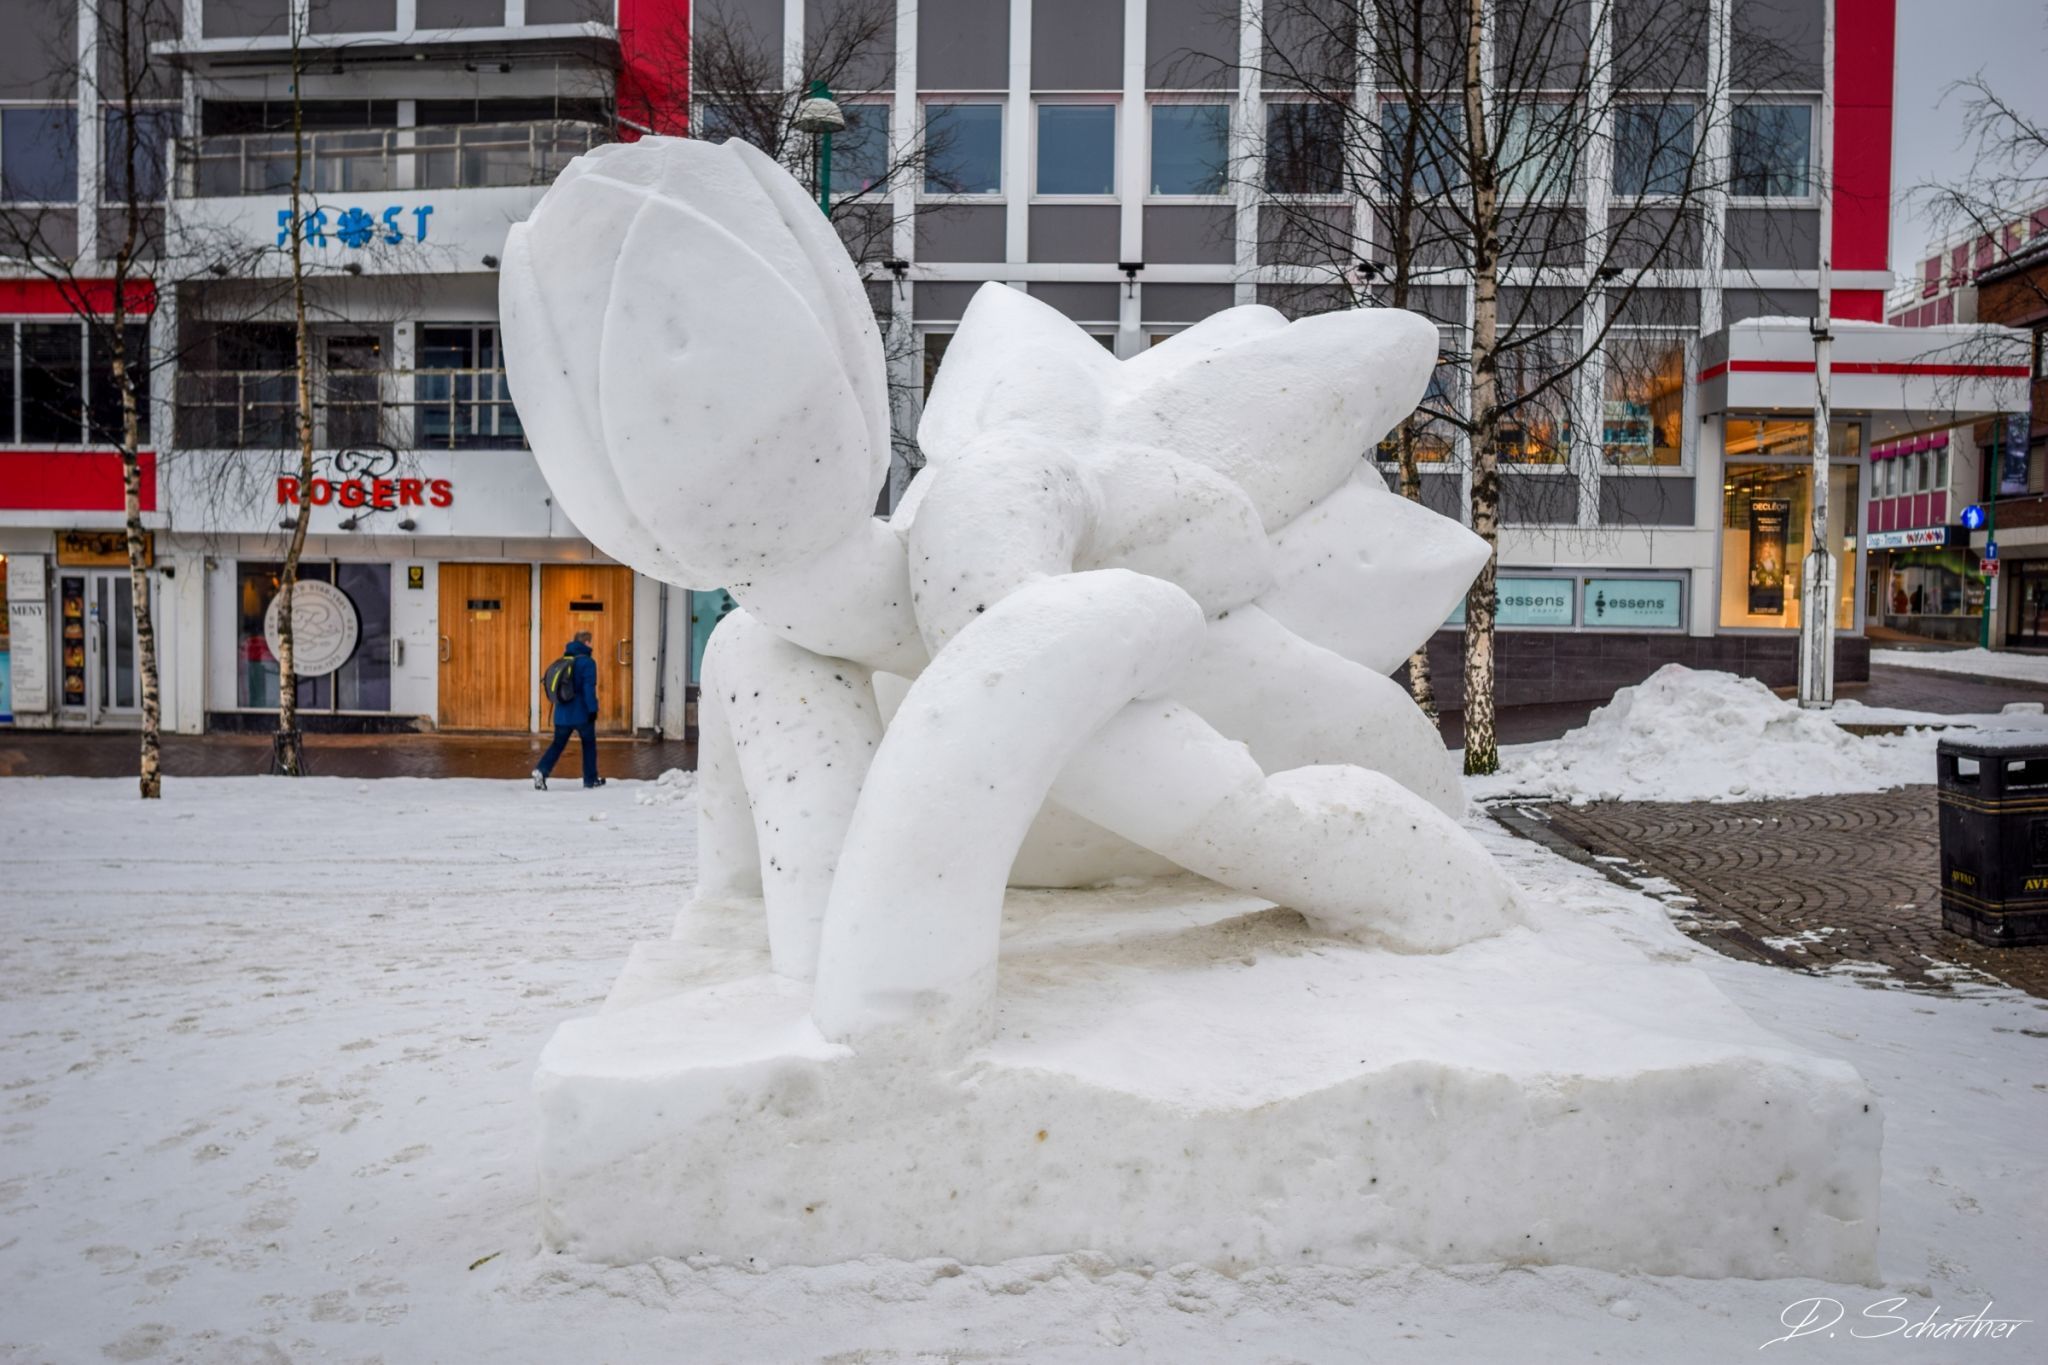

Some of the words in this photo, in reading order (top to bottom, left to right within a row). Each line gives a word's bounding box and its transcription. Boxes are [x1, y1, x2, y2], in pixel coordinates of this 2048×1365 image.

[277, 205, 433, 248] FROST
[277, 477, 453, 508] ROGER'S
[1505, 594, 1565, 607] essens
[1609, 598, 1664, 609] essens
[11, 605, 43, 616] MENY
